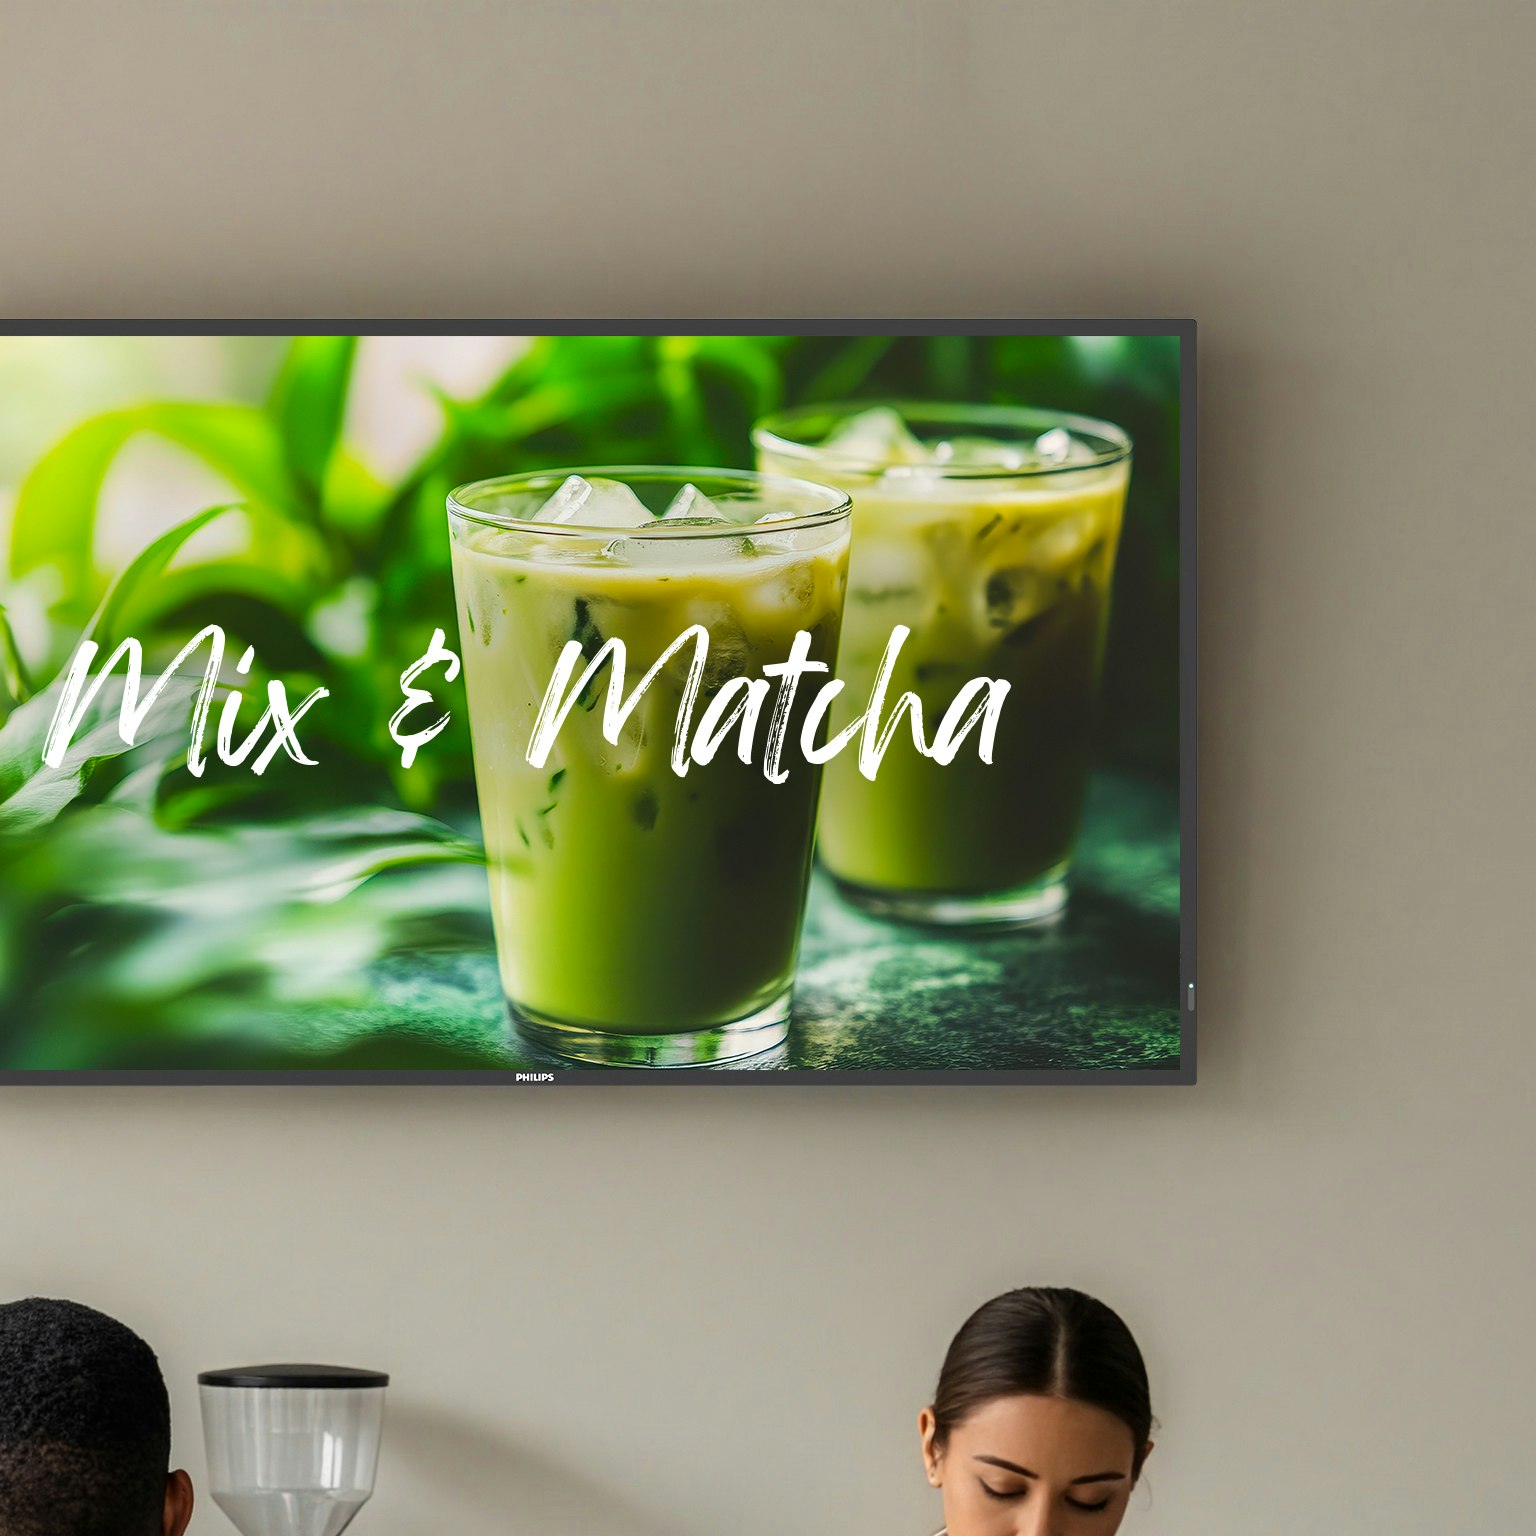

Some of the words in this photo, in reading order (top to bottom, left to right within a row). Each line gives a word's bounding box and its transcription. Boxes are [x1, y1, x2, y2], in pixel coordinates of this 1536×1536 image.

[42, 624, 331, 779] Mix
[389, 628, 461, 769] &
[525, 624, 1013, 786] Matcha
[515, 1073, 555, 1082] PHILIPS
